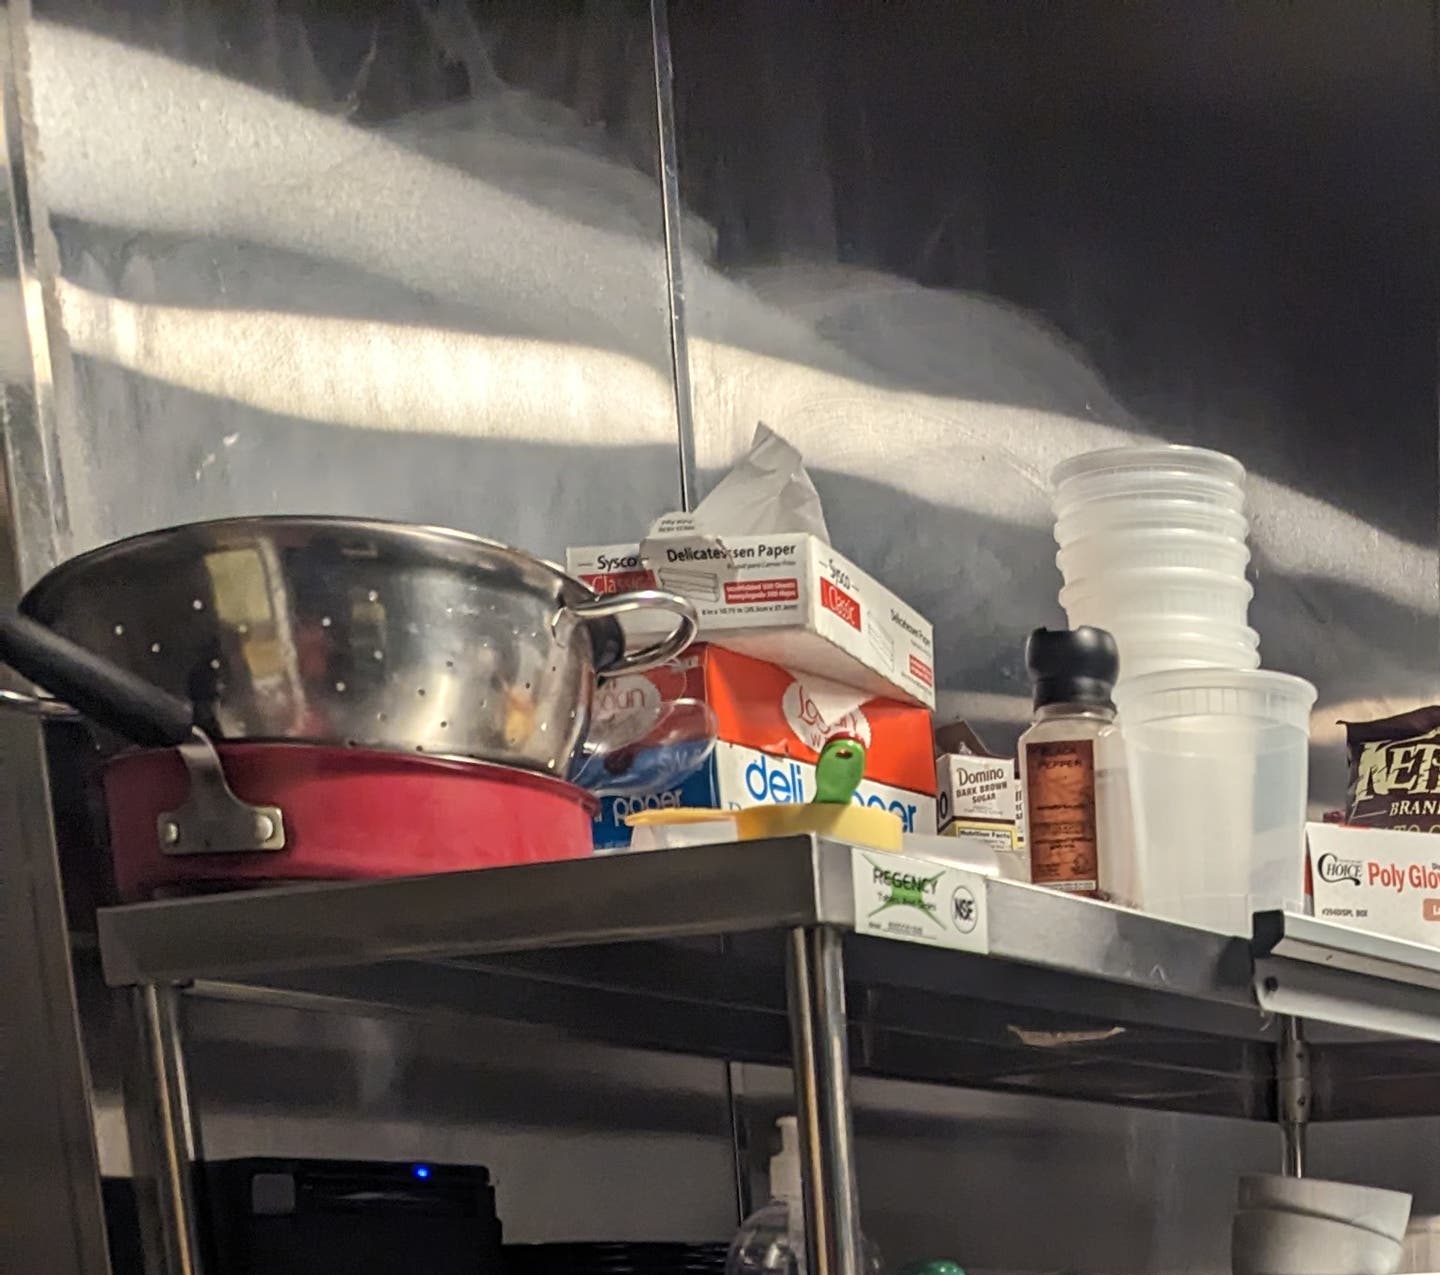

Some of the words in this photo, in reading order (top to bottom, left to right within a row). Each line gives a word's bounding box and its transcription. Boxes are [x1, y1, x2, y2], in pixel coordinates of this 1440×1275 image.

[597, 554, 637, 573] Sysco
[757, 544, 796, 562] Paper
[828, 559, 851, 590] Sysco
[744, 756, 805, 804] deli
[956, 767, 1004, 786] Domino
[956, 786, 977, 798] DARK
[980, 781, 1008, 794] BROWN
[972, 793, 996, 804] SUGAR
[872, 865, 939, 895] REGENCY
[1317, 852, 1363, 886] CHOICE
[1367, 862, 1406, 893] Poly
